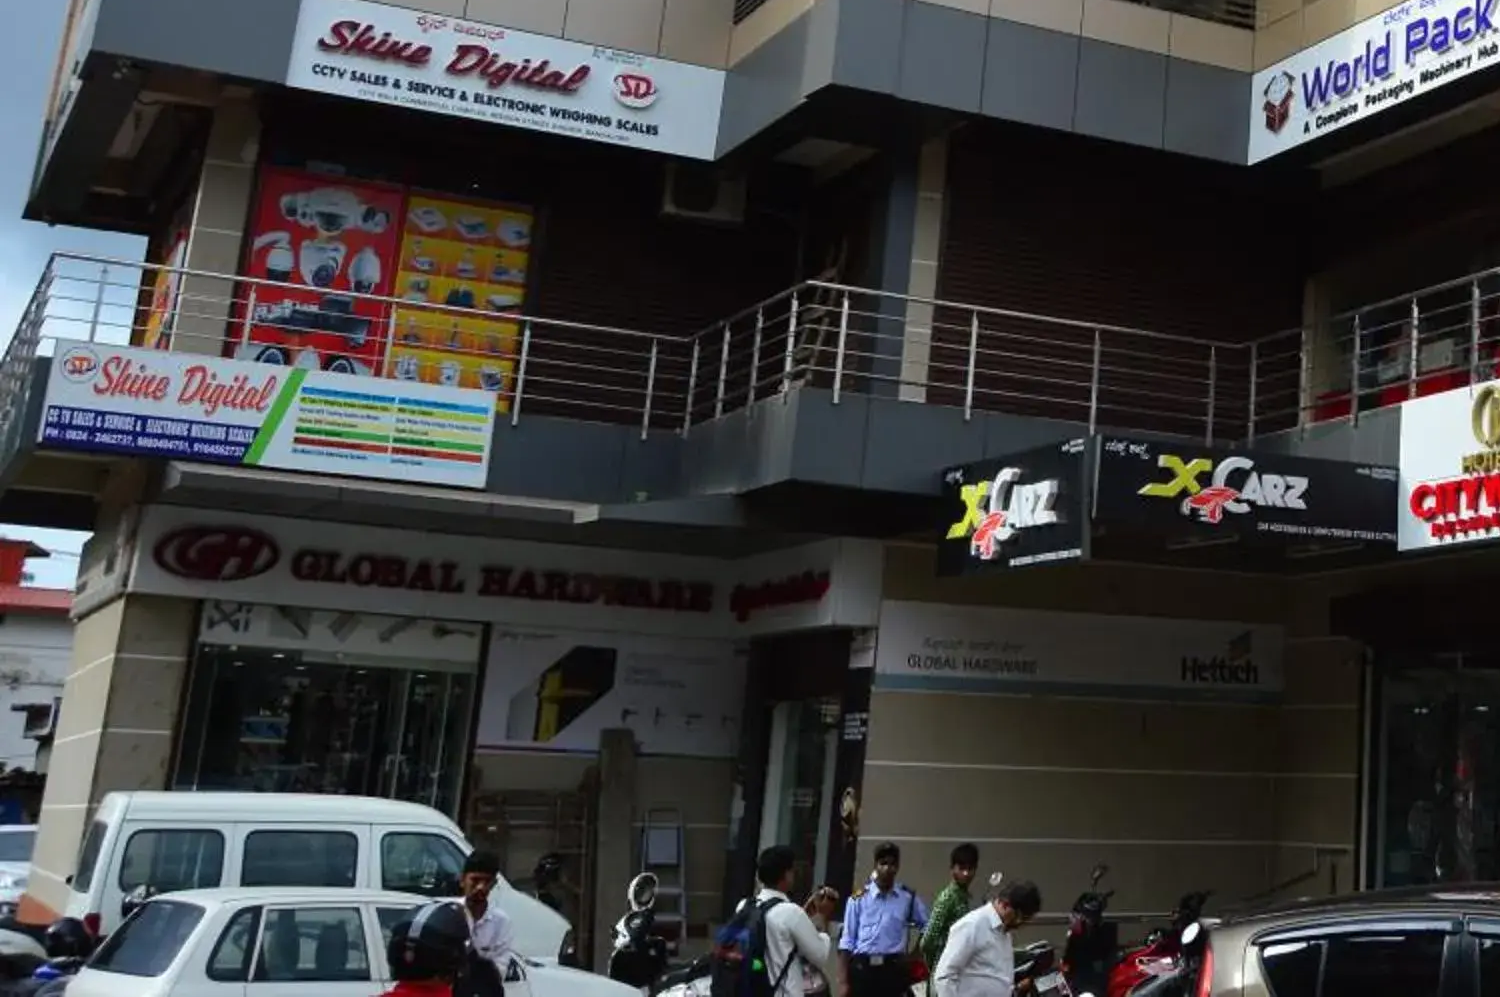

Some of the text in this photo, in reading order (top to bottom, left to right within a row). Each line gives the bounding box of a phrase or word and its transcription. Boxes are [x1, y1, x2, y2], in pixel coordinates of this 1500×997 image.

[317, 20, 591, 95] Shine Digital
[1302, 30, 1391, 110] World
[1303, 121, 1312, 134] A
[1315, 103, 1359, 130] Complete
[1365, 78, 1415, 107] Packaging
[1478, 41, 1499, 61] Hub
[312, 63, 660, 137] CCTV SALES & SERVICE & ELECTRONIC WEIGHING SCALES
[94, 355, 277, 417] Shine Digital
[291, 549, 465, 593] GLOBAL
[478, 564, 714, 613] HARDWARE
[907, 653, 1038, 675] GLOBAL HARDWARE
[1180, 657, 1260, 685] Hettich
